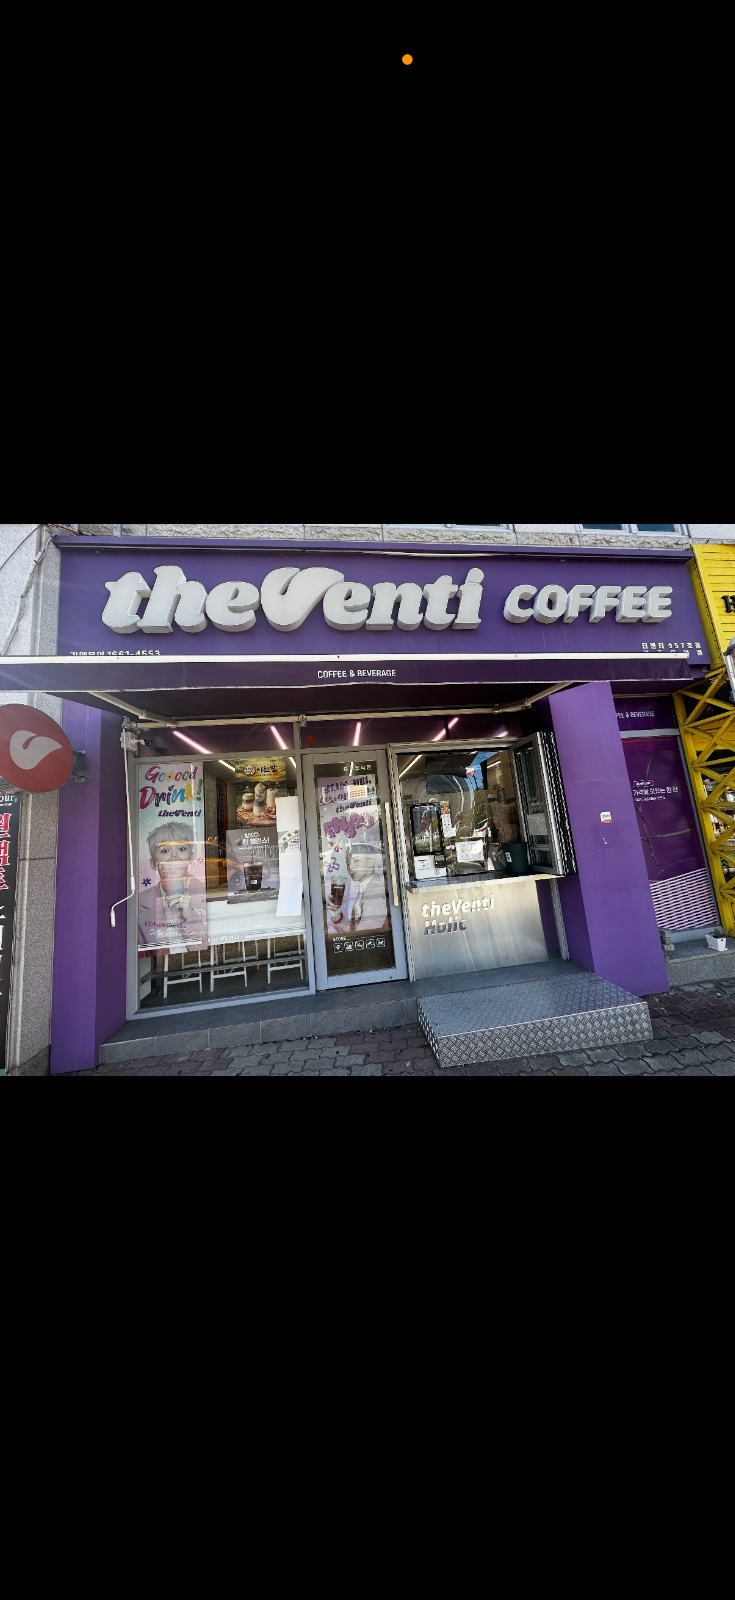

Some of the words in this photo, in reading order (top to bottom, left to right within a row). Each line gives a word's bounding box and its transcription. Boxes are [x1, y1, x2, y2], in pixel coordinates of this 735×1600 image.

[102, 565, 483, 633] theVenti
[503, 584, 673, 624] COFFEE
[317, 670, 348, 679] COFFEE
[349, 669, 355, 678] &
[357, 669, 396, 677] BEVERAGE
[630, 710, 655, 718] BEVERAGE
[139, 778, 203, 810] Drink!
[158, 809, 202, 817] theVenti
[421, 893, 495, 918] theVenti
[424, 915, 467, 937] Holic
